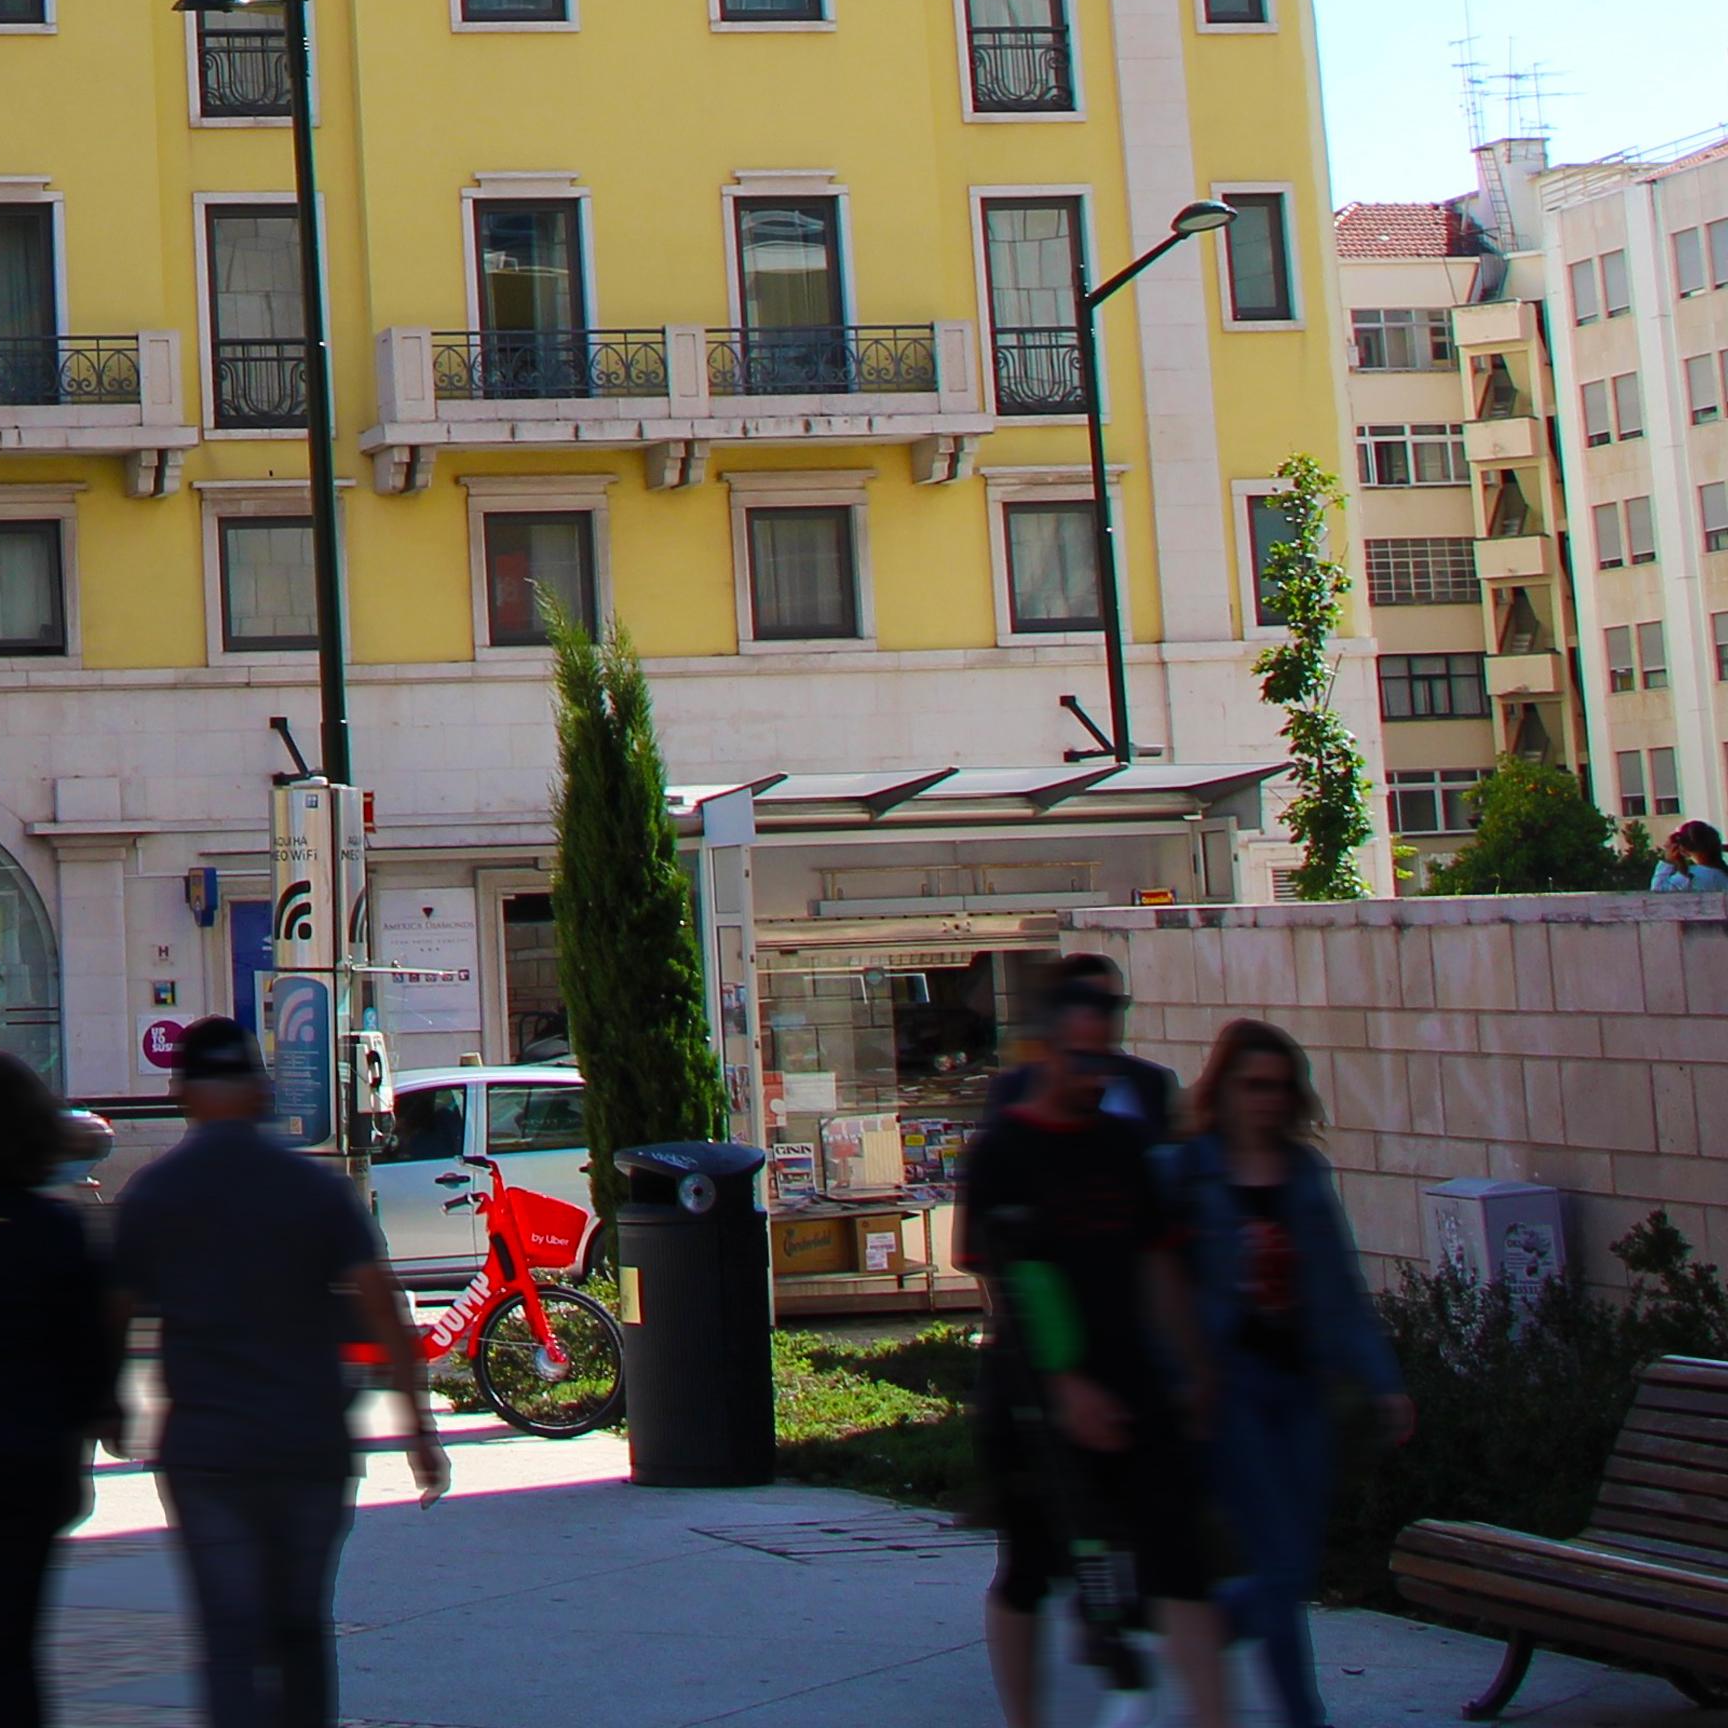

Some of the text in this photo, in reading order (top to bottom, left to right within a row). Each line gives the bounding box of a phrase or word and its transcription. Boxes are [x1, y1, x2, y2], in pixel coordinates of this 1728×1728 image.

[291, 848, 318, 861] WiFi
[151, 1027, 165, 1035] UP
[152, 1035, 165, 1044] TO
[531, 1233, 569, 1246] by Uber
[432, 1272, 492, 1347] JUMP
